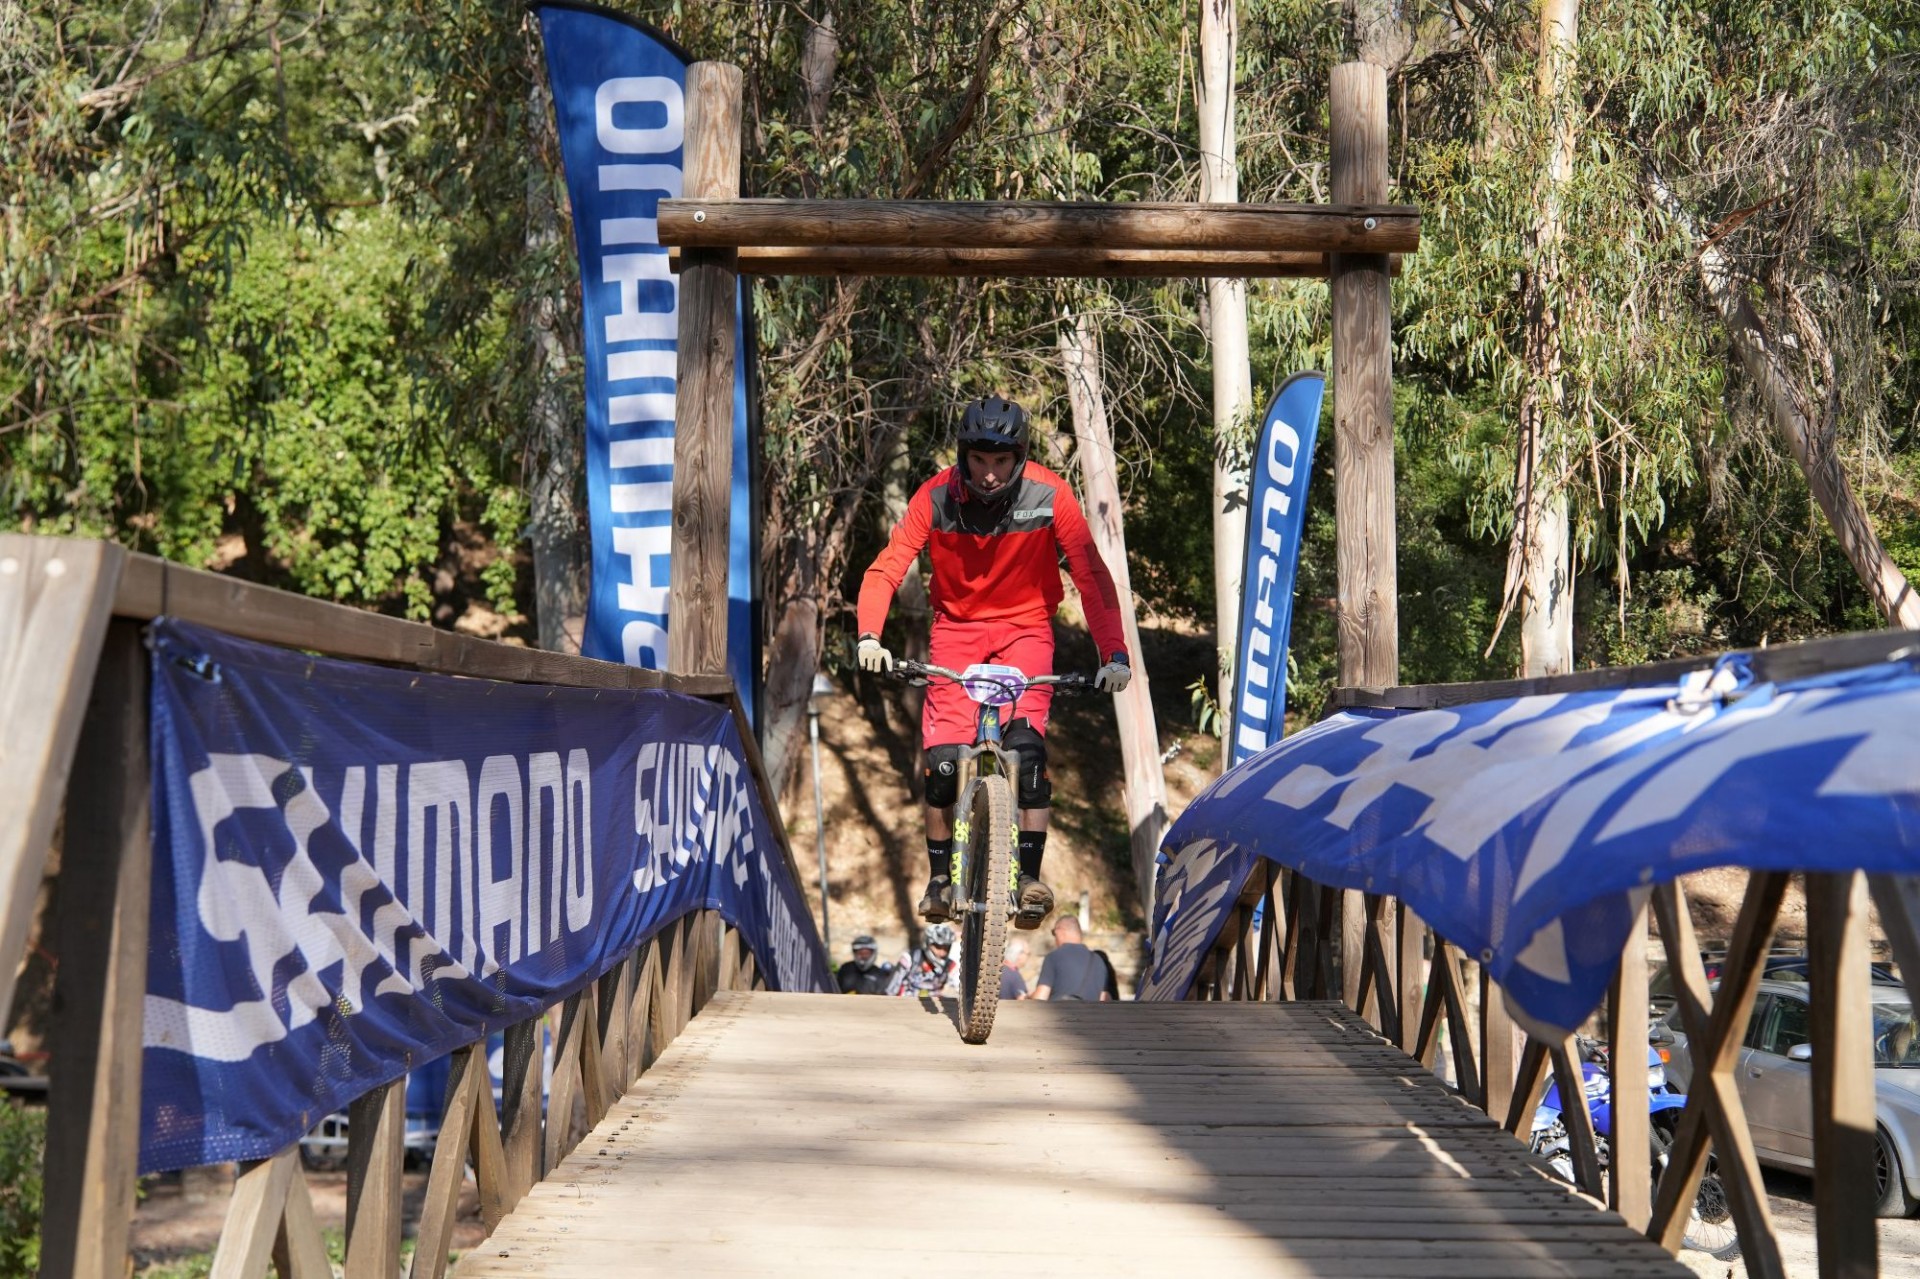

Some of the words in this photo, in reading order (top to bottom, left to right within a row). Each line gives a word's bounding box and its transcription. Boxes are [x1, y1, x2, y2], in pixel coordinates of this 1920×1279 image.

[1237, 419, 1300, 763] IMANO
[954, 818, 970, 844] 36
[951, 851, 963, 886] FOX
